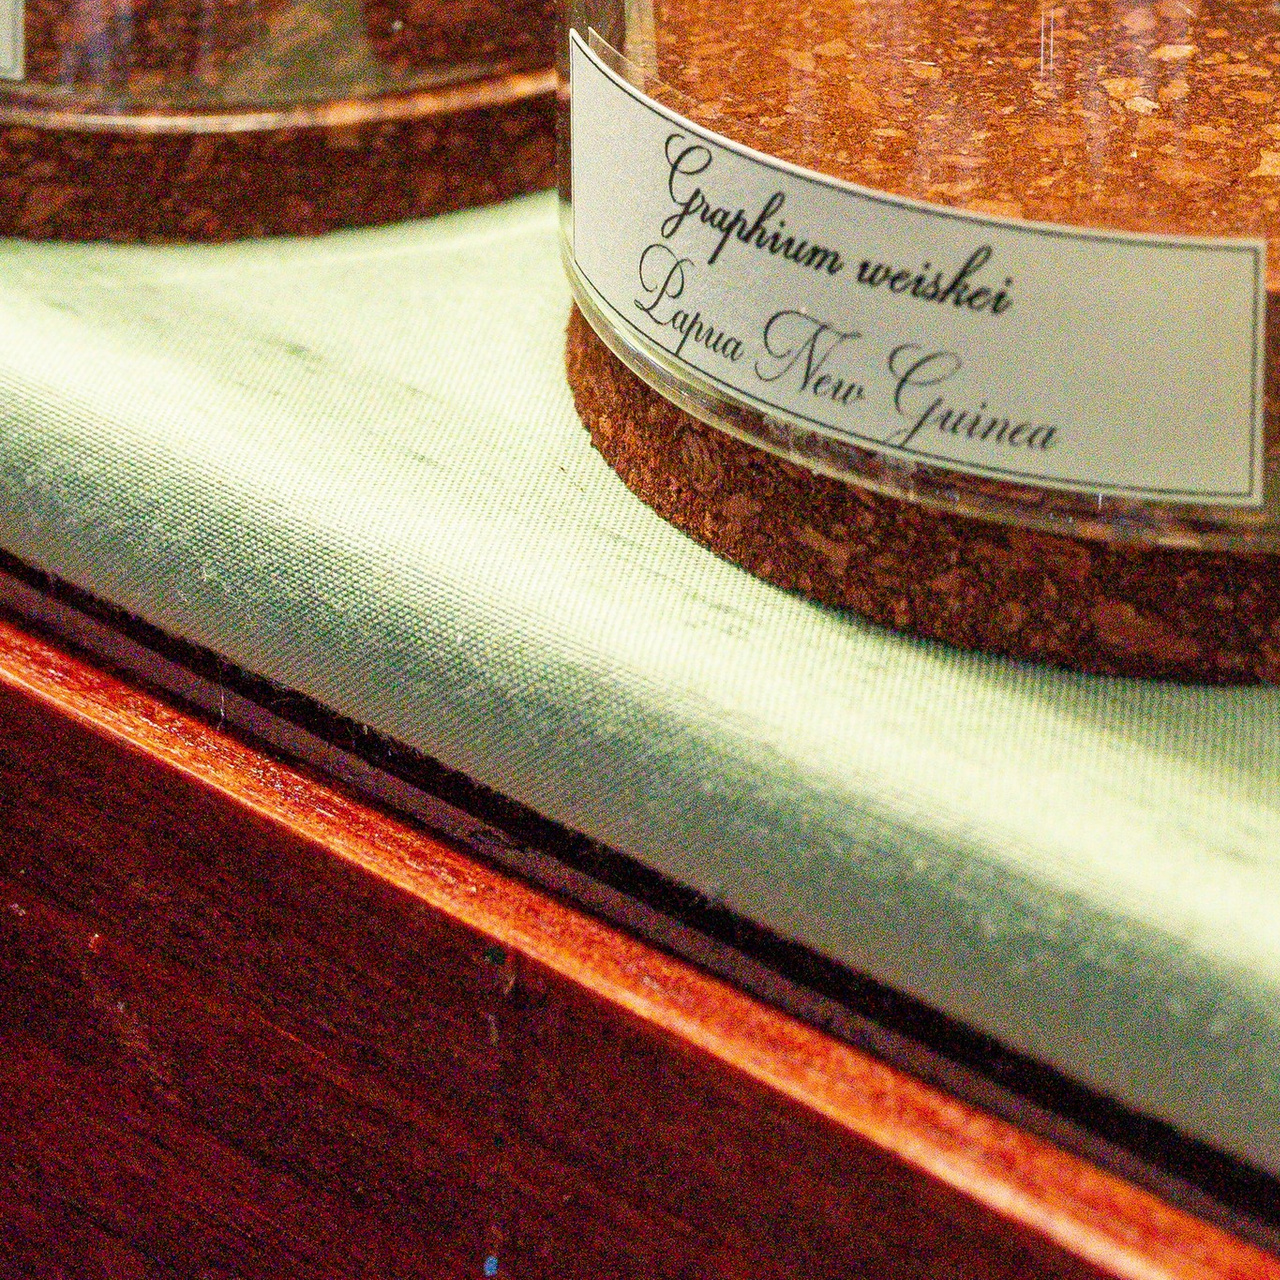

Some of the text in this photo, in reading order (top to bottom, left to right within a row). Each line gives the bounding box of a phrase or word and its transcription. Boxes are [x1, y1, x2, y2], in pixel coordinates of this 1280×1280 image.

[661, 134, 1012, 314] Graphium weiskei
[634, 243, 1058, 448] Papua New Guinea
